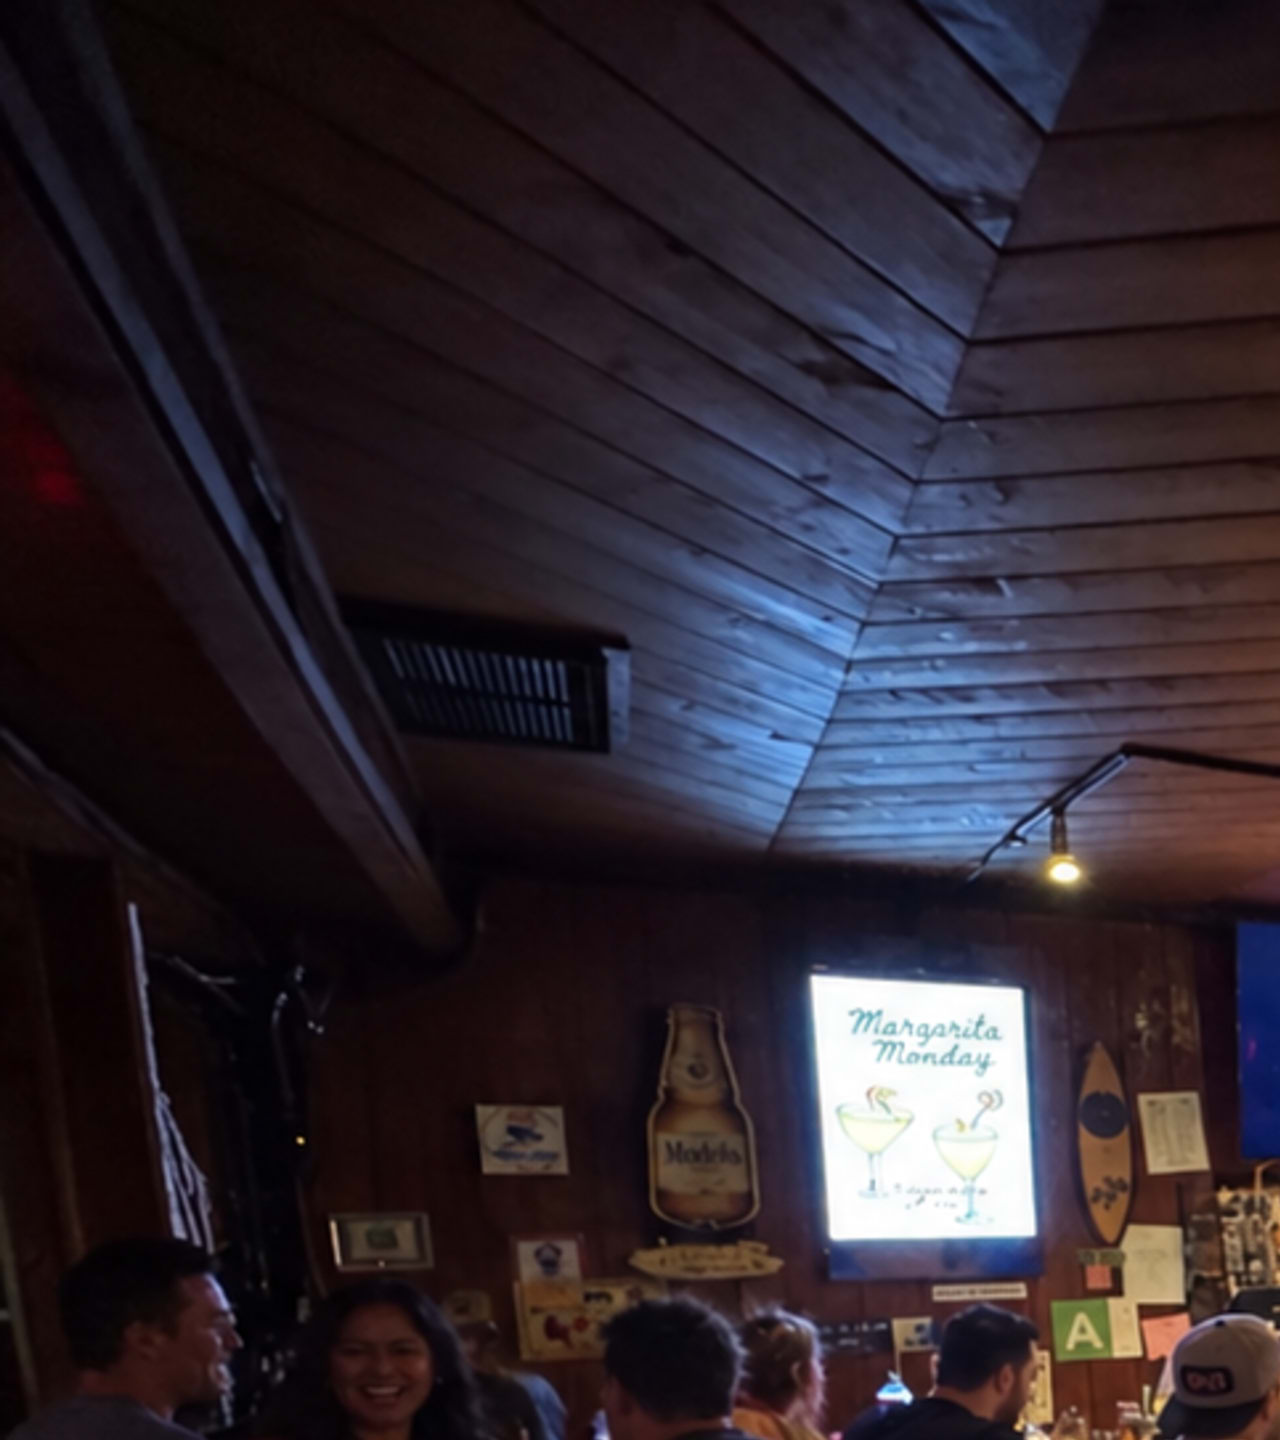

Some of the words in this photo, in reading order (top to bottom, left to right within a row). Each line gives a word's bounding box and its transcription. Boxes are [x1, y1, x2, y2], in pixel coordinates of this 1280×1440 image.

[848, 1007, 1003, 1047] Margarita
[871, 1038, 997, 1078] Monday
[1066, 1311, 1104, 1351] A
